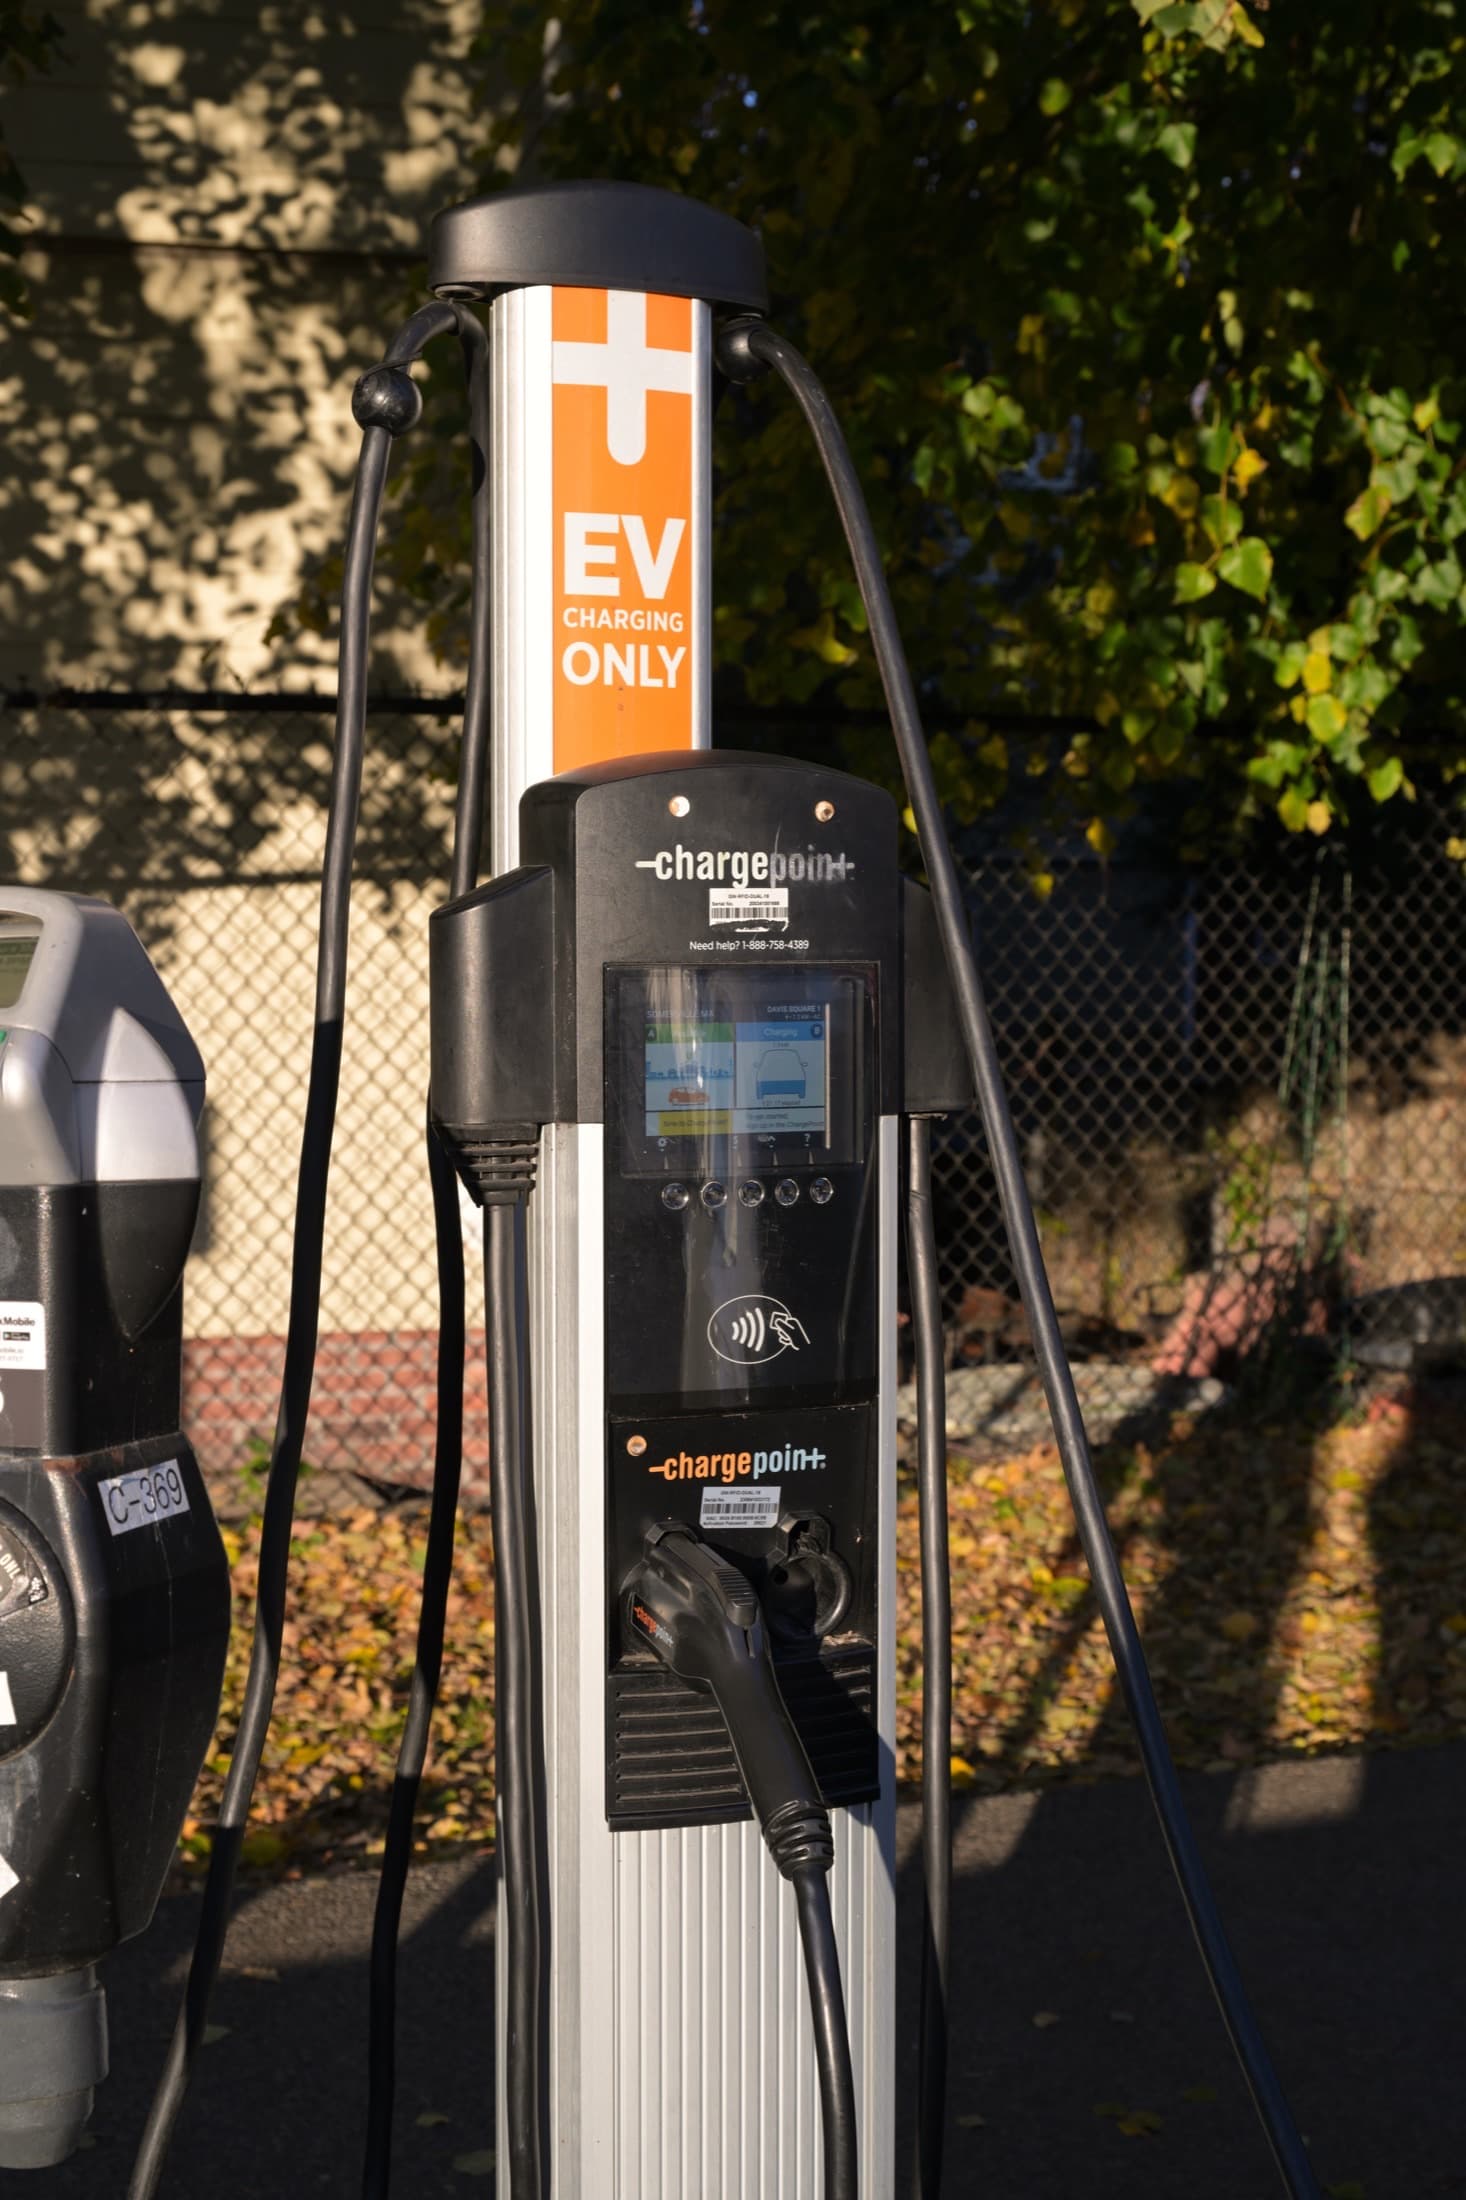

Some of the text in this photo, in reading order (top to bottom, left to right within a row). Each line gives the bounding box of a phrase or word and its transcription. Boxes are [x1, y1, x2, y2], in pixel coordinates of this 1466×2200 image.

[563, 512, 686, 599] EV
[562, 607, 684, 632] CHARGING
[562, 641, 686, 689] ONLY
[635, 844, 855, 888] chargepoint
[689, 939, 810, 951] Need help? 1-888-758-4389
[649, 1444, 826, 1483] chargepoint
[108, 1468, 183, 1524] C-369
